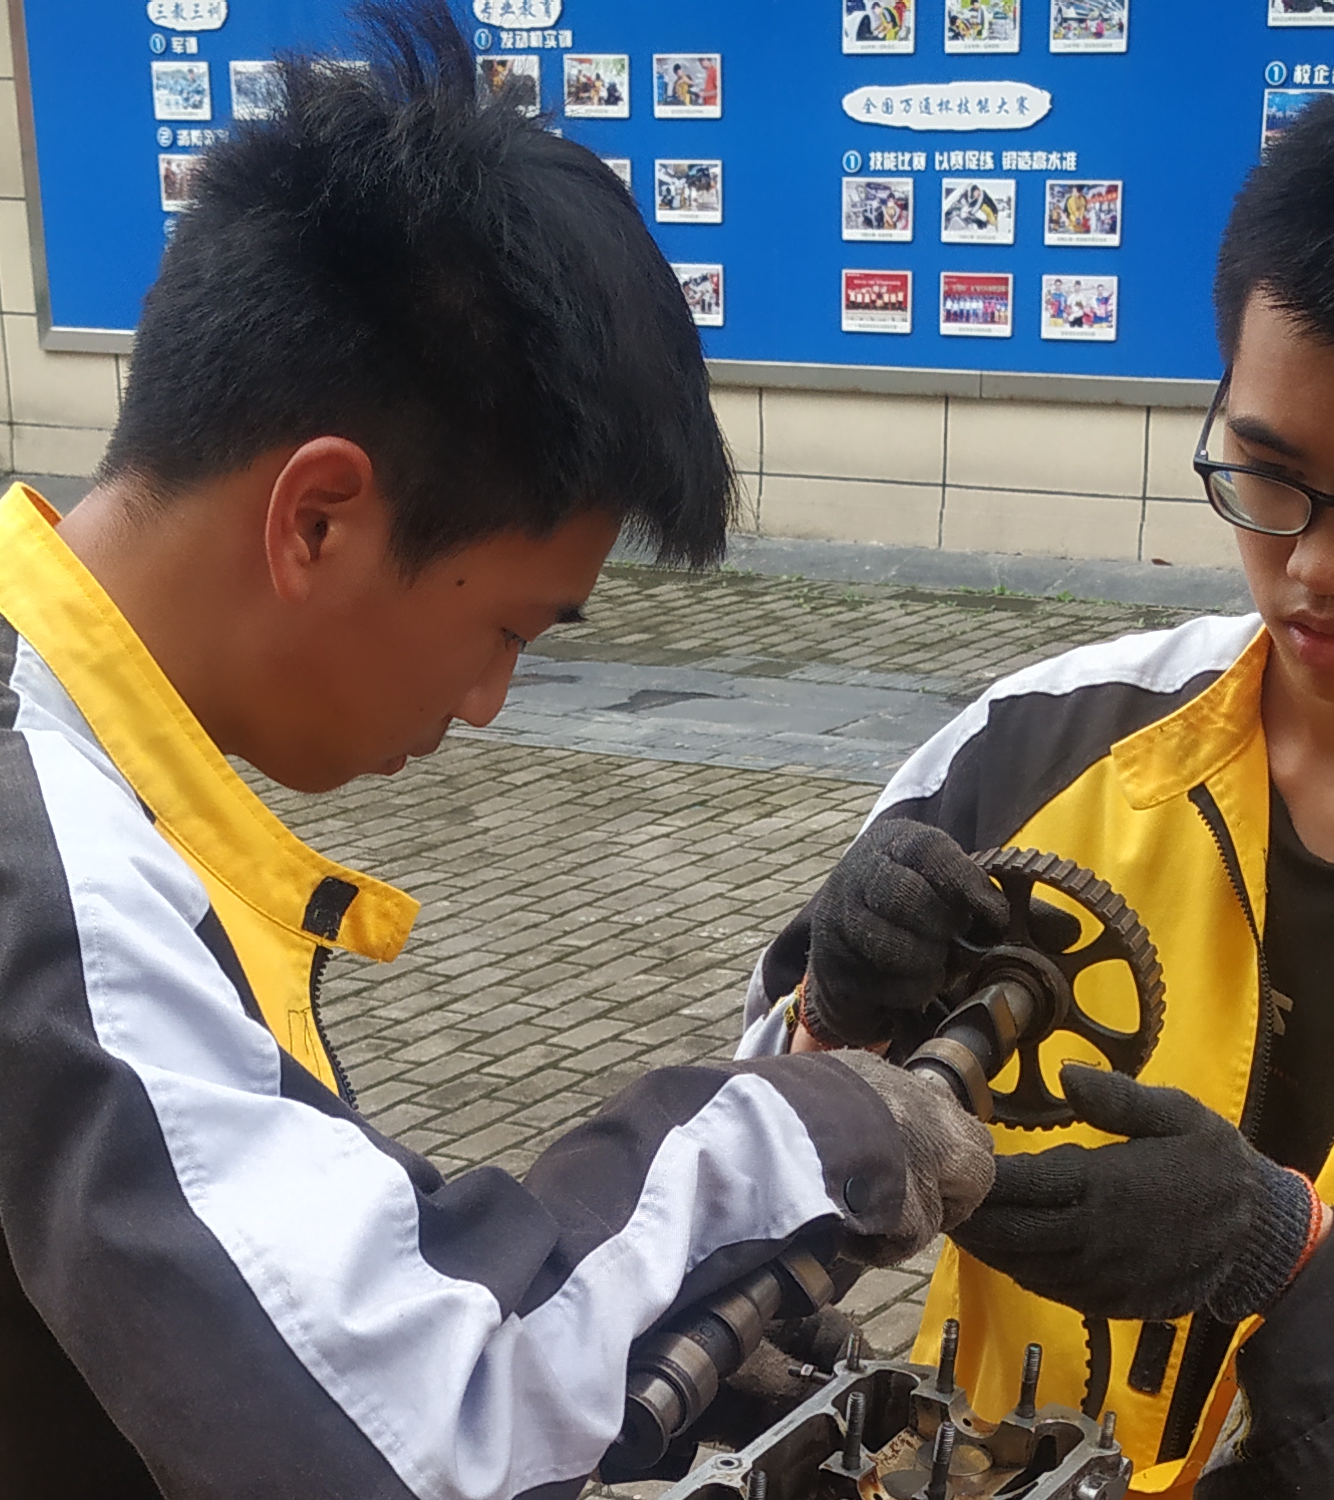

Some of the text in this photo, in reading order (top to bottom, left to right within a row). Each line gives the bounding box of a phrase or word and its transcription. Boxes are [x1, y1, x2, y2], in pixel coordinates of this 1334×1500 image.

[861, 96, 1031, 116] 全国万通杯技能大赛
[868, 151, 927, 171] 技能比赛
[934, 151, 995, 171] 以赛促练
[1001, 151, 1078, 171] 锻造高水准
